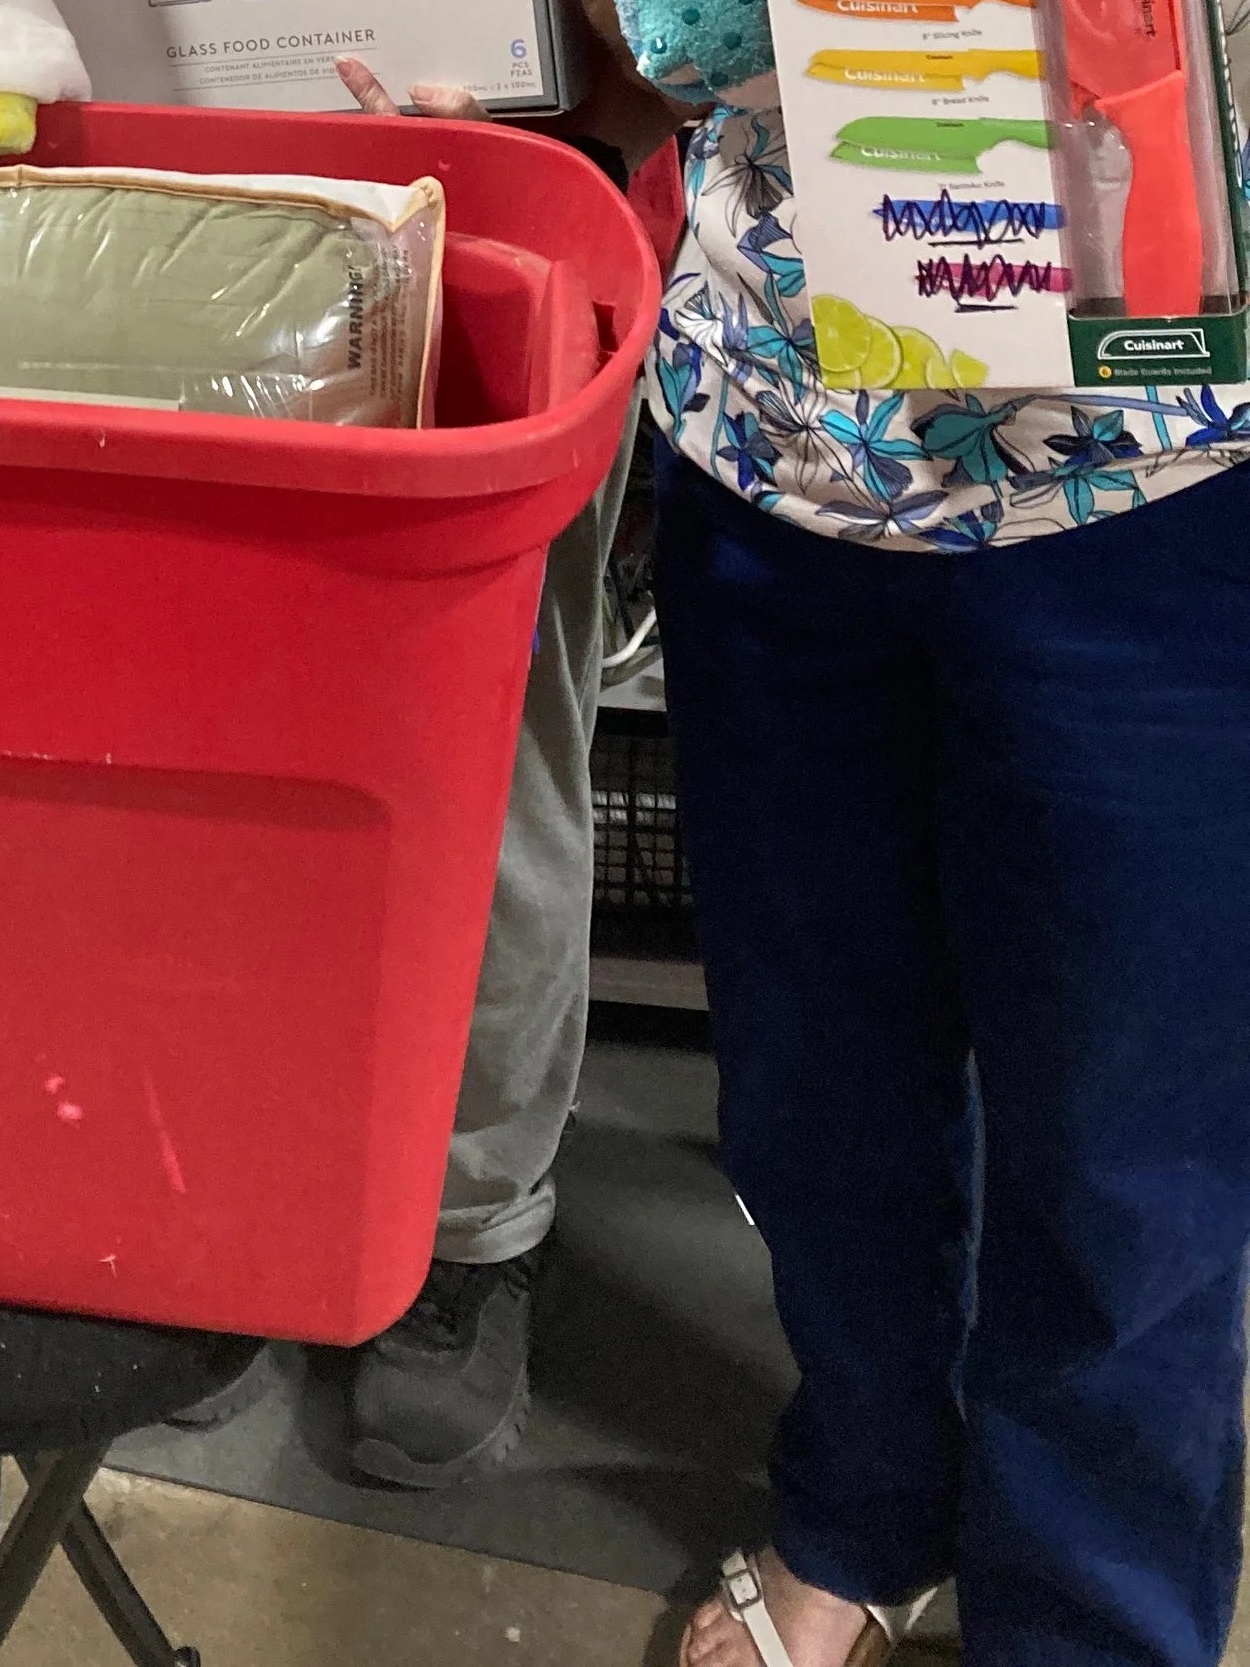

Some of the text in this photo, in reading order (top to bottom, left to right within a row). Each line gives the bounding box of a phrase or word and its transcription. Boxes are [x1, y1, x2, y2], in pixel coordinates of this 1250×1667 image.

[166, 29, 376, 58] GLASS FOOD CONTAINER
[510, 38, 527, 59] 6
[199, 73, 250, 84] CONTENEDOR
[264, 69, 307, 80] ALIMENTOS
[204, 63, 250, 74] CONTENANT
[347, 265, 364, 370] WARNING!
[1124, 340, 1185, 351] Cuisinart
